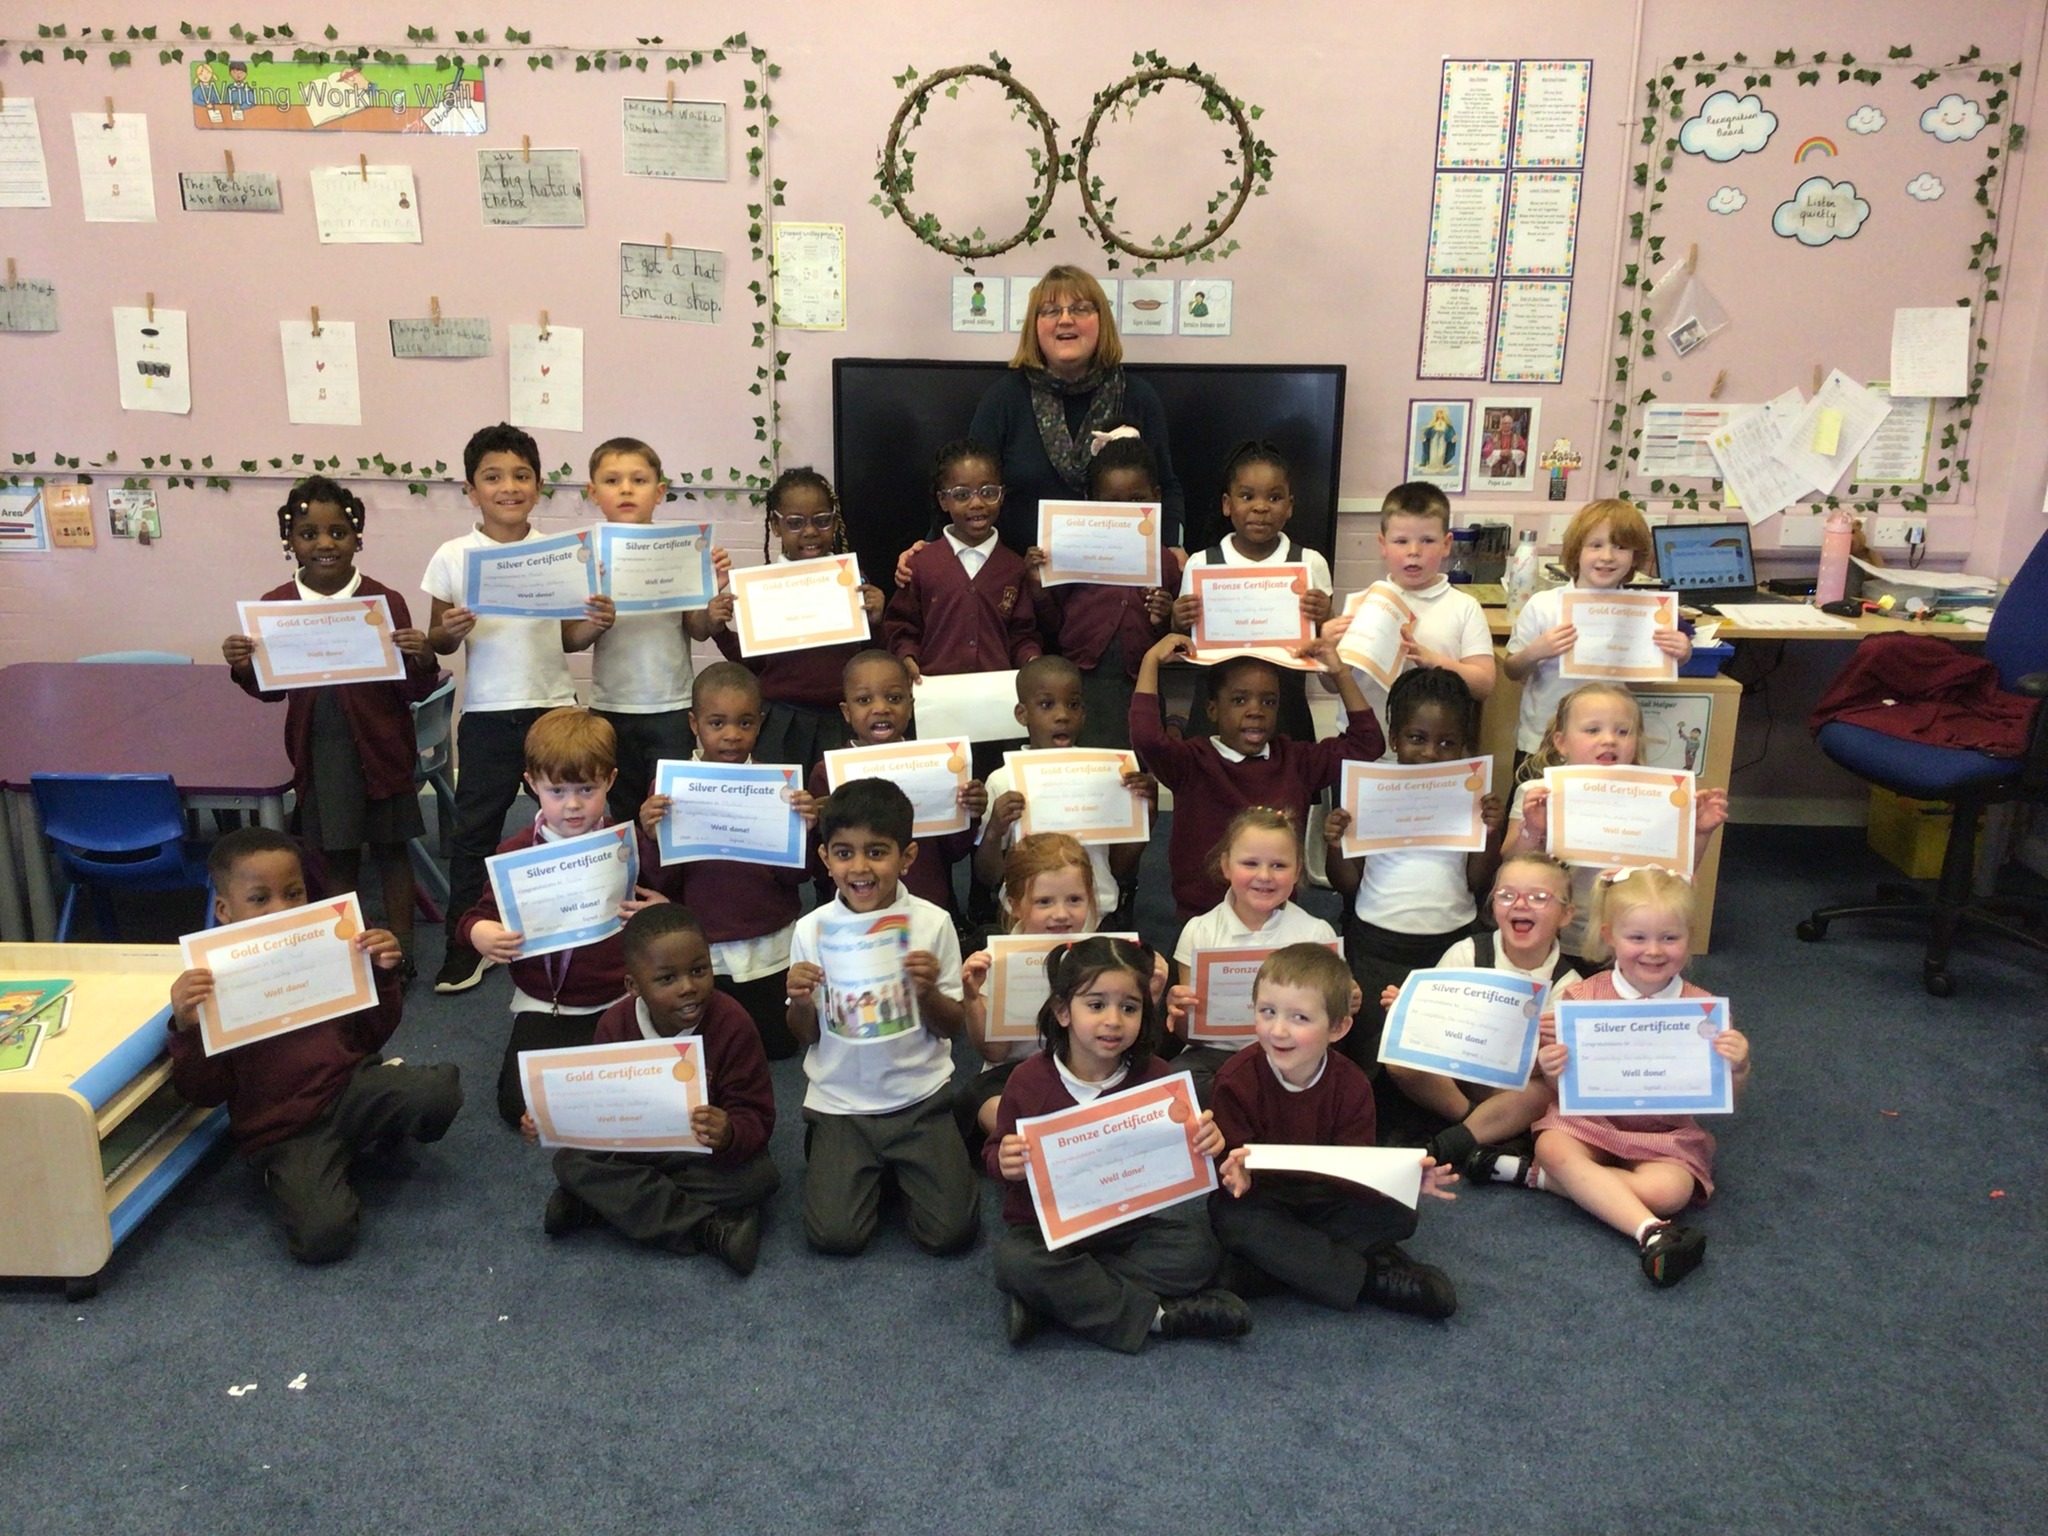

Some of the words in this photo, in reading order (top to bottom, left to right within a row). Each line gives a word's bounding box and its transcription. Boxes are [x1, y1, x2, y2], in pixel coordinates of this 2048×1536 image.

[200, 81, 290, 111] Writing
[299, 81, 406, 113] Working
[415, 82, 471, 108] Wall
[1706, 113, 1758, 128] Recognition
[1716, 127, 1745, 137] Board
[483, 165, 496, 184] A
[1806, 195, 1837, 208] Listen
[1800, 209, 1838, 228] quietly
[622, 255, 635, 272] I
[641, 246, 663, 278] got
[672, 264, 685, 277] a
[693, 249, 722, 283] hat
[663, 292, 678, 306] a
[686, 282, 722, 324] shop.
[1, 508, 23, 517] Area
[1066, 519, 1085, 527] Gold
[1088, 519, 1132, 530] Certificate
[625, 540, 650, 551] Silver
[653, 538, 692, 551] Certificate
[497, 559, 523, 570] Silver
[527, 551, 573, 566] Certificate
[1212, 582, 1241, 590] Bronze
[1244, 580, 1289, 591] Certificate
[277, 618, 300, 628] Gold
[303, 615, 357, 626] Certificate
[863, 765, 885, 774] Gold
[888, 759, 940, 771] Certificate
[1041, 767, 1062, 775] Gold
[1065, 764, 1112, 774] Certificate
[688, 782, 717, 793] Silver
[720, 784, 775, 797] Certificate
[1377, 782, 1400, 792] Gold
[1404, 779, 1457, 791] Certificate
[1583, 782, 1607, 793] Gold
[1610, 784, 1663, 798] Certificate
[711, 823, 728, 832] Well
[729, 826, 750, 834] done!
[526, 864, 557, 879] Silver
[559, 851, 613, 871] Certificate
[560, 903, 578, 914] Well
[580, 899, 601, 910] done!
[230, 945, 260, 960] Gold
[263, 927, 326, 951] Certificate
[1222, 965, 1258, 974] Bronze
[263, 986, 284, 999] Well
[285, 980, 310, 993] done!
[1431, 984, 1460, 994] Silver
[1463, 986, 1521, 1007] Certificate
[1594, 1022, 1626, 1033] Silver
[1630, 1020, 1691, 1035] Certificate
[1445, 1029, 1463, 1039] Well
[1465, 1034, 1488, 1046] done!
[565, 1071, 594, 1083] Gold
[598, 1065, 663, 1080] Certificate
[1622, 1069, 1641, 1077] Well
[1643, 1068, 1666, 1077] done!
[596, 1115, 616, 1123] Well
[618, 1114, 643, 1123] done!
[1057, 1128, 1100, 1149] Bronze
[1102, 1108, 1165, 1136] Certificate
[1099, 1174, 1120, 1186] Well
[1121, 1165, 1145, 1178] done!
